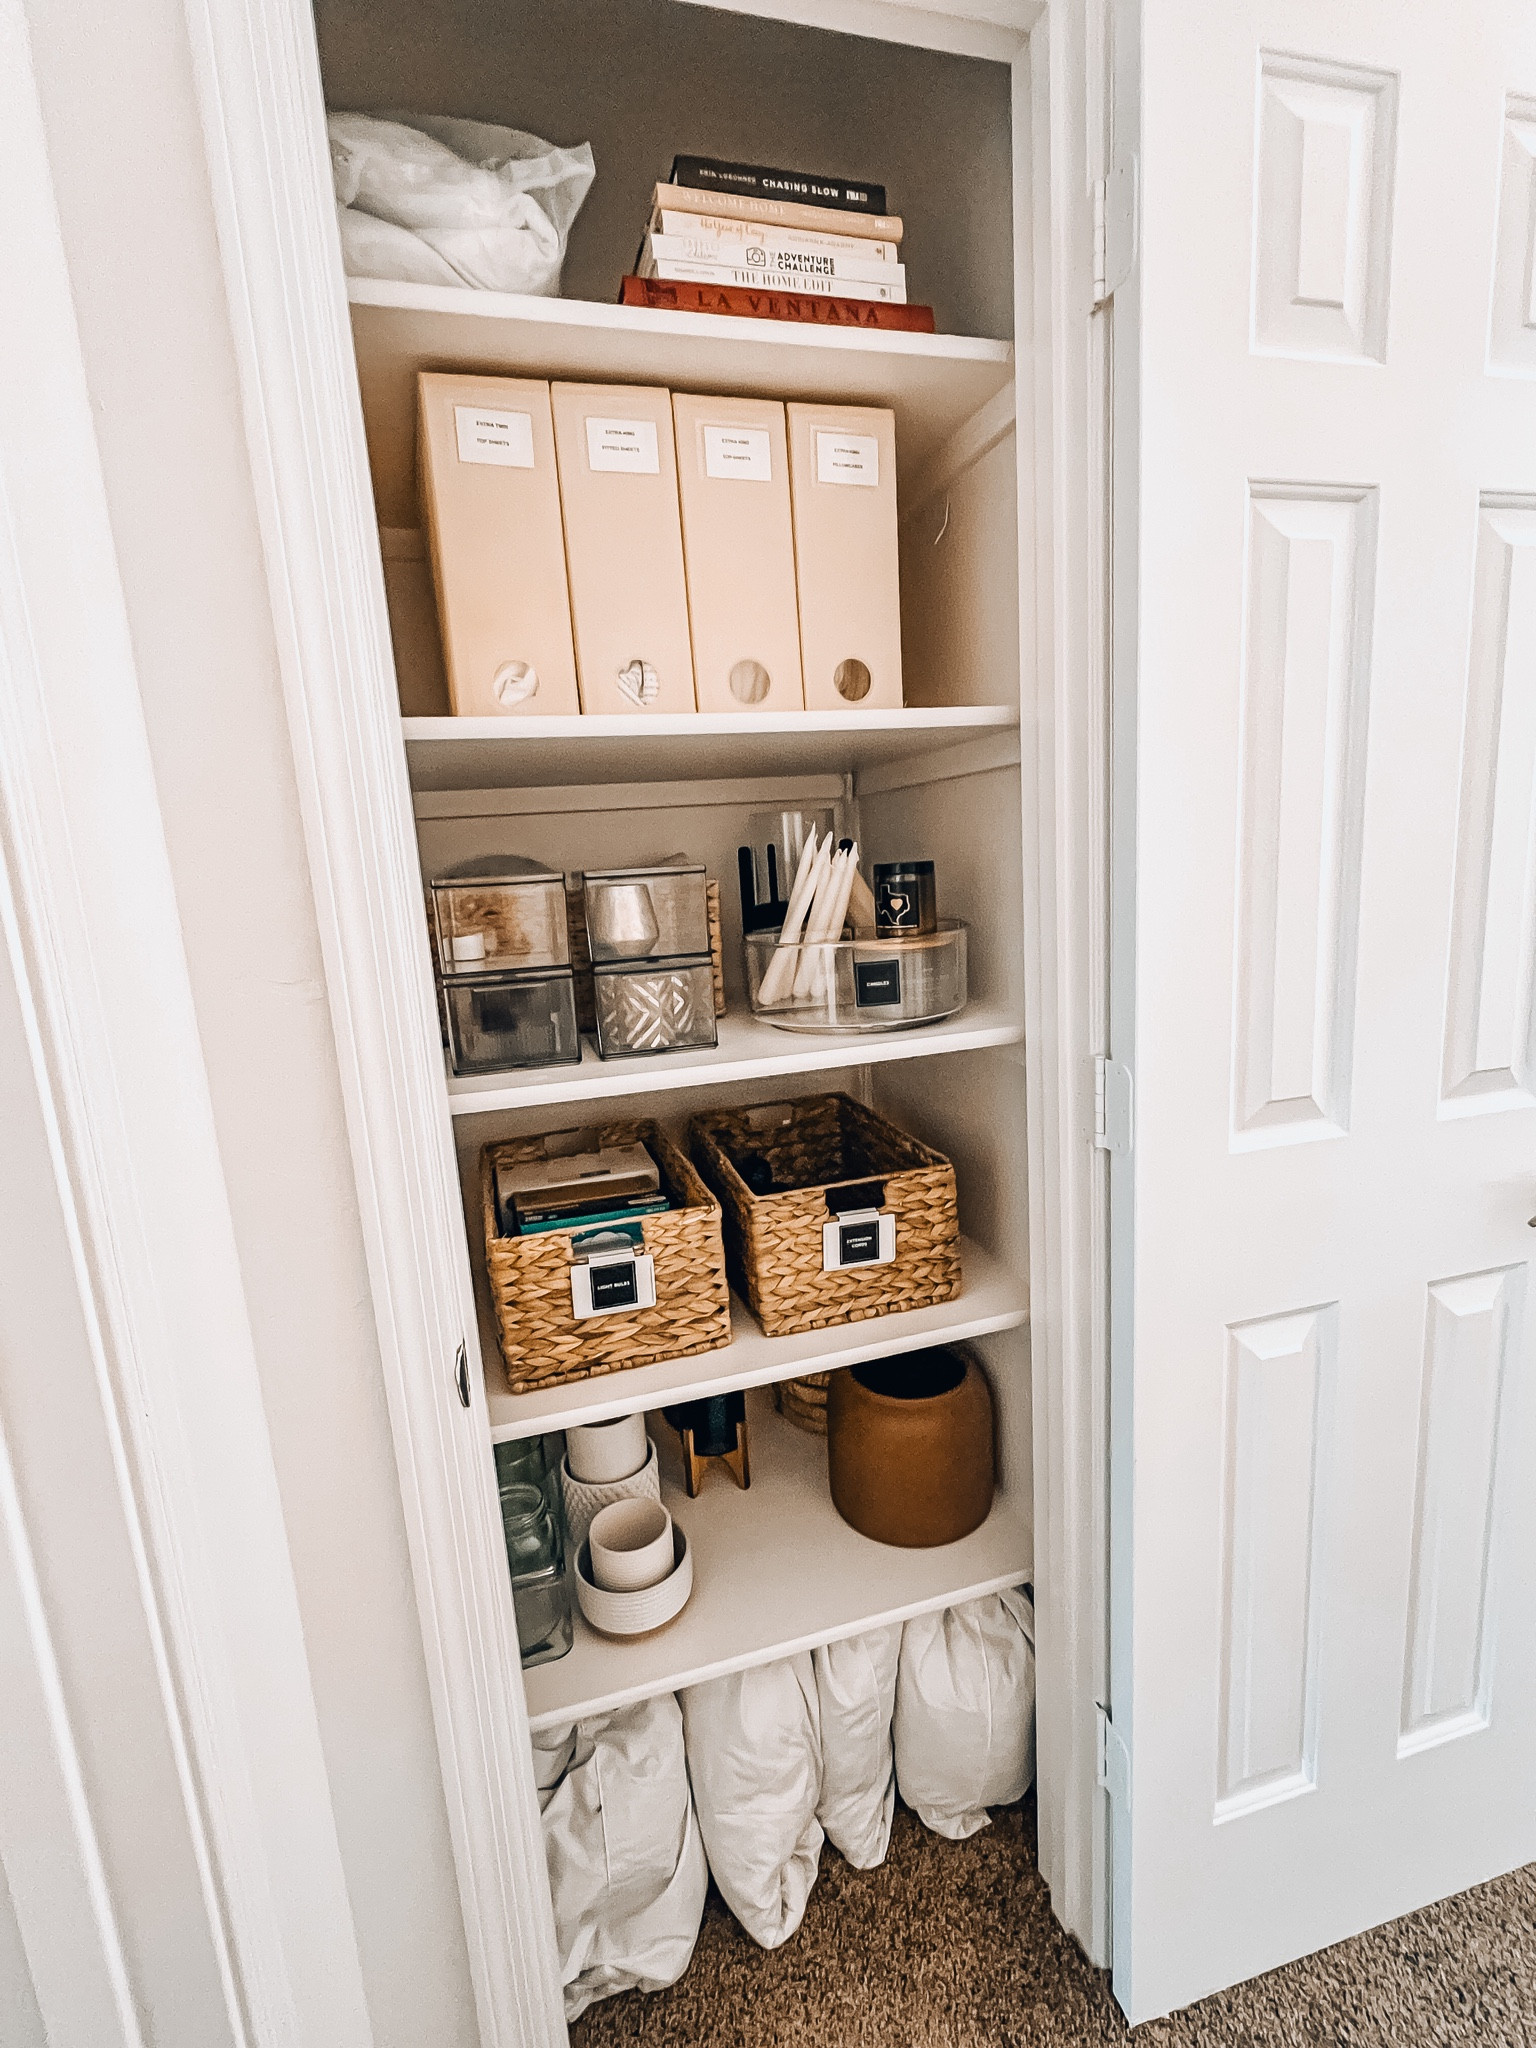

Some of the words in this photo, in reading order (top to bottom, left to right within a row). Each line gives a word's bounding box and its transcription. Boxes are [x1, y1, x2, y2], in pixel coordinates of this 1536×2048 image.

[762, 178, 808, 193] CHASING
[811, 184, 839, 198] SLOW
[682, 190, 745, 209] WELCOME
[749, 201, 785, 217] HOME
[778, 252, 835, 266] ADVENTURE
[778, 261, 836, 275] CHALLENGE
[732, 270, 759, 284] THE
[762, 273, 800, 289] HOME
[803, 277, 834, 293] EDIT
[697, 290, 732, 309] LA
[746, 294, 880, 325] VENTANA
